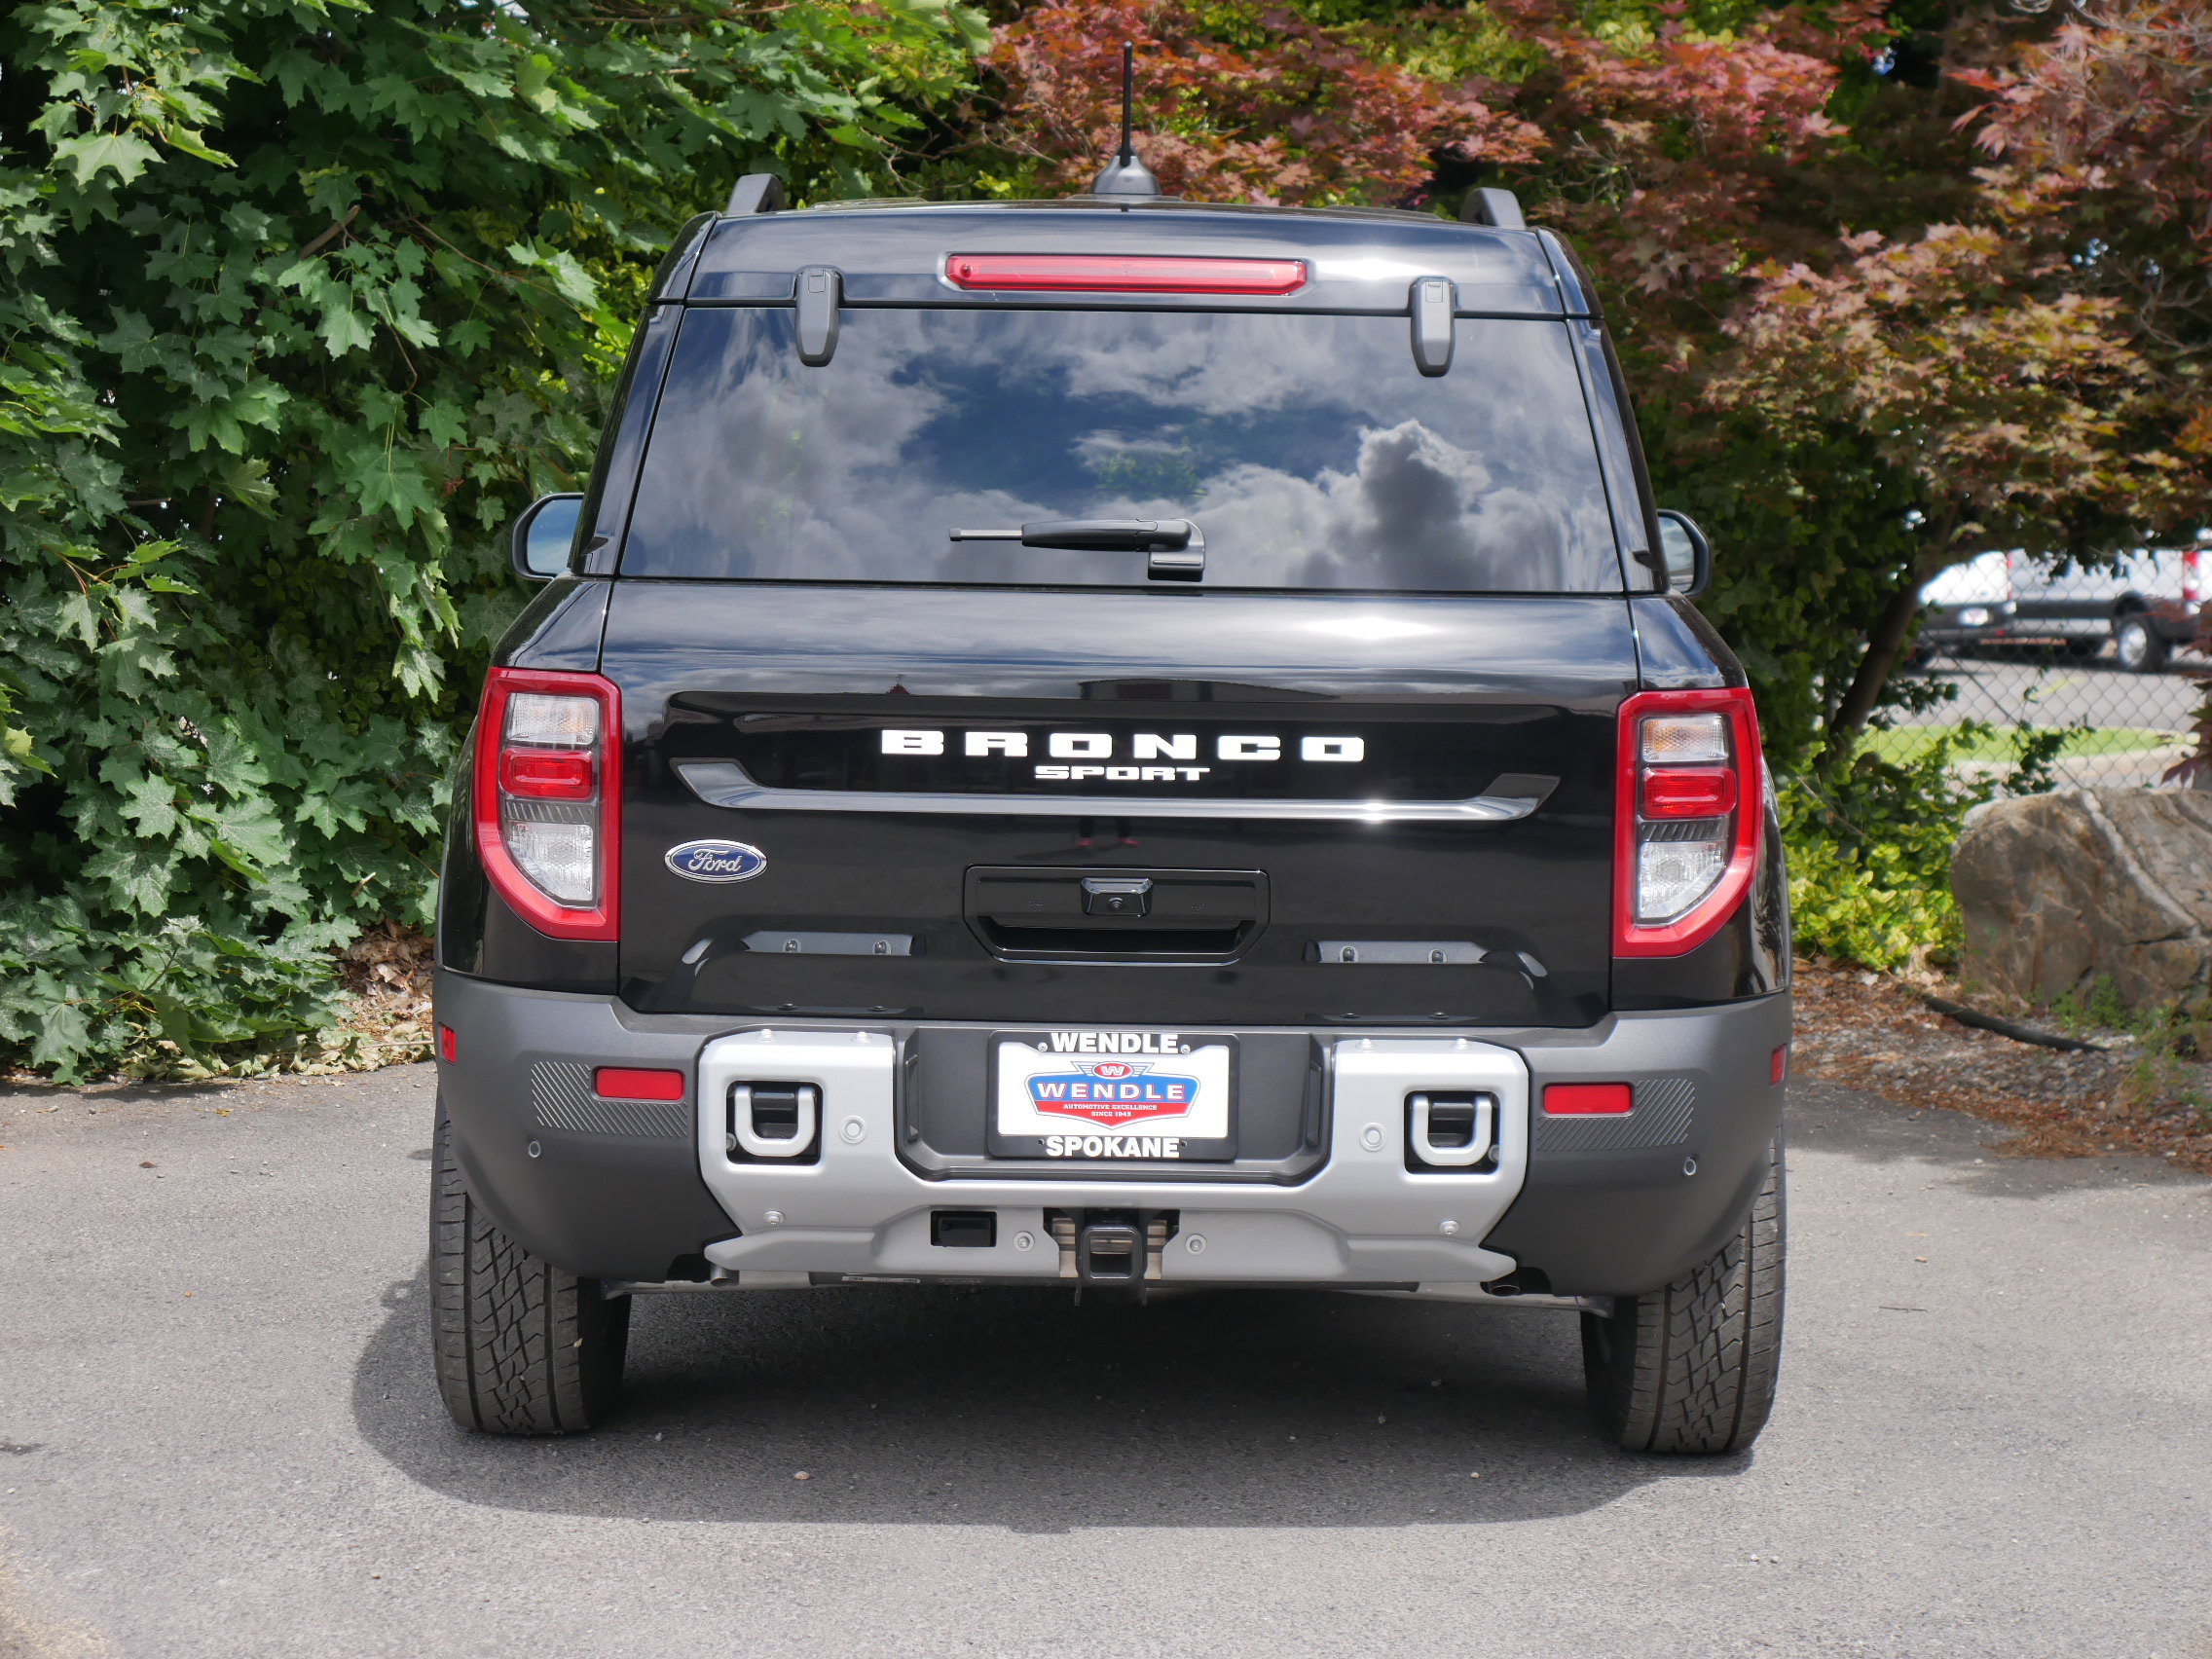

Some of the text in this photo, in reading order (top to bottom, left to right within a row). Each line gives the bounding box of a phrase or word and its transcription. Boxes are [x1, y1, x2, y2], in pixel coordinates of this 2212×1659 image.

[881, 729, 1365, 762] BRONCO
[1035, 765, 1211, 781] SPORT
[687, 848, 743, 872] Ford
[1051, 1032, 1179, 1054] WENDLE
[1036, 1082, 1185, 1101] WENDLE
[1046, 1136, 1180, 1159] SPOKANE
